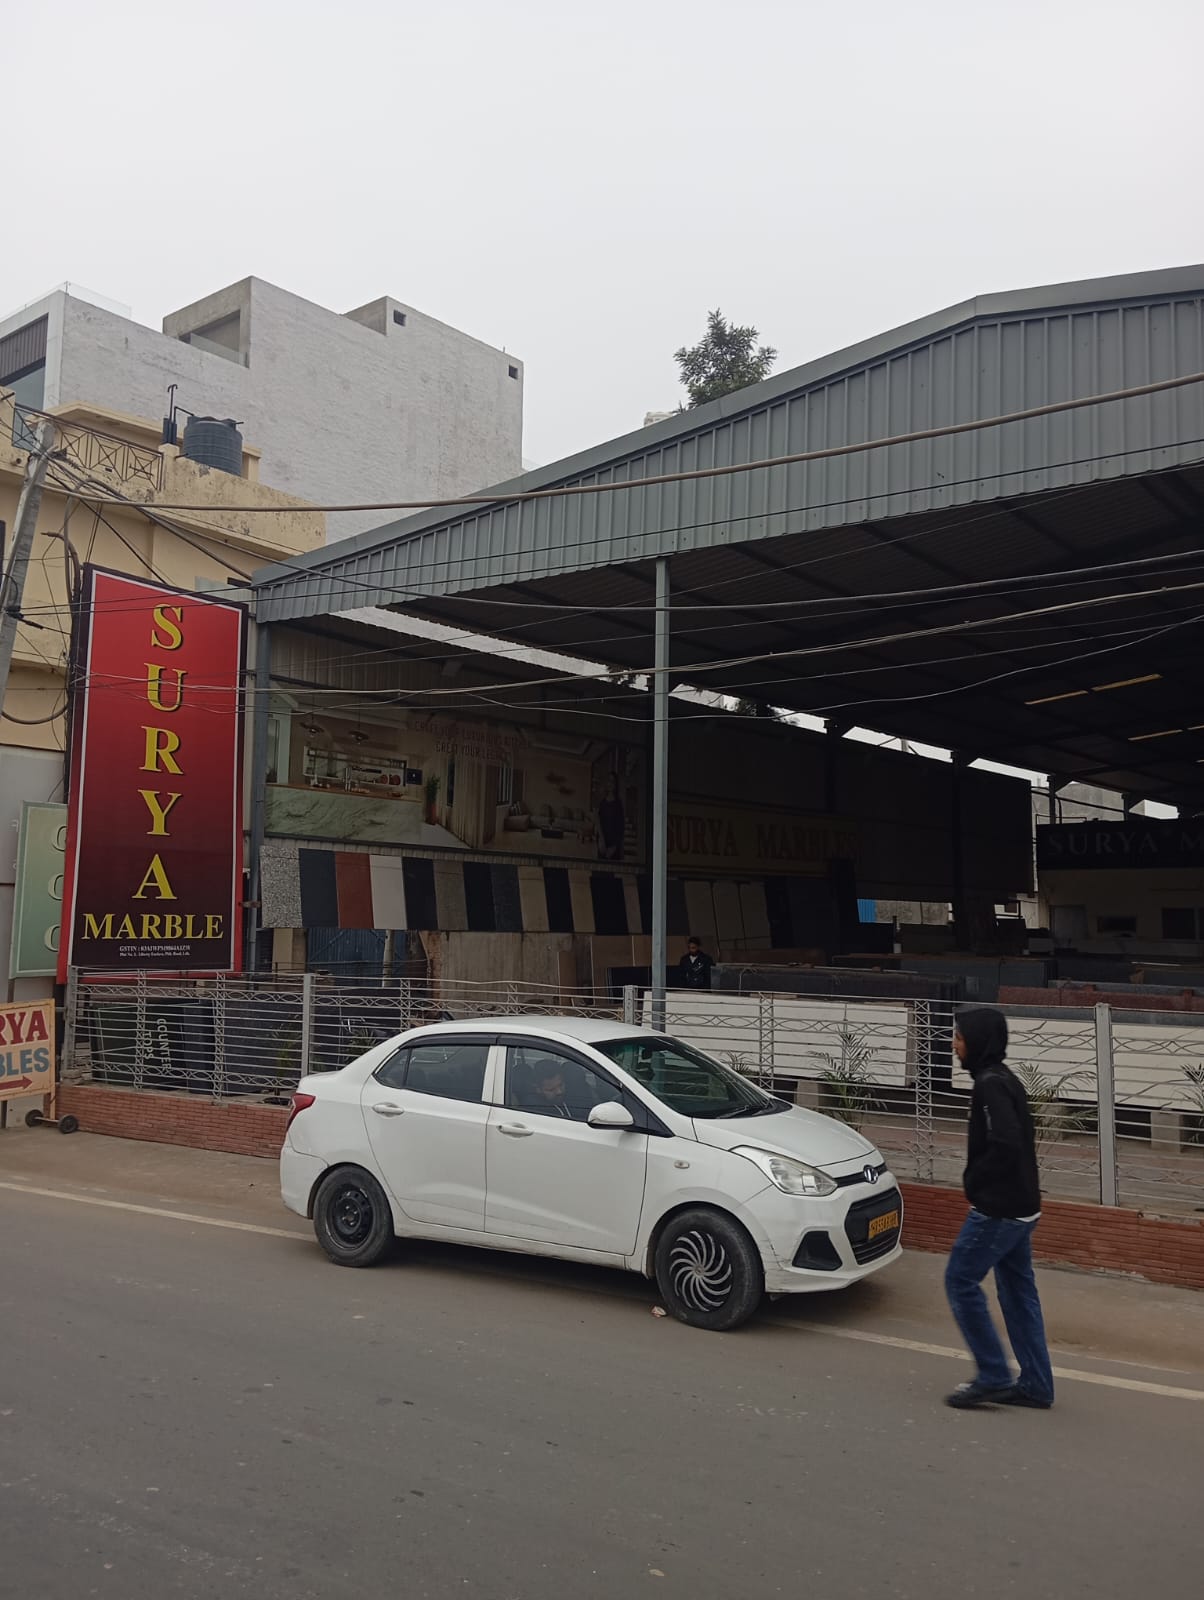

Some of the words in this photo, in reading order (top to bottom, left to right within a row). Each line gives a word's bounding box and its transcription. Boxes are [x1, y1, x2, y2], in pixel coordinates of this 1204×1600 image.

[132, 602, 188, 900] SURYA
[1048, 831, 1159, 856] SURYA
[81, 913, 224, 940] MARBLE
[143, 1031, 154, 1060] TOPS
[156, 1018, 172, 1072] COUNTER
